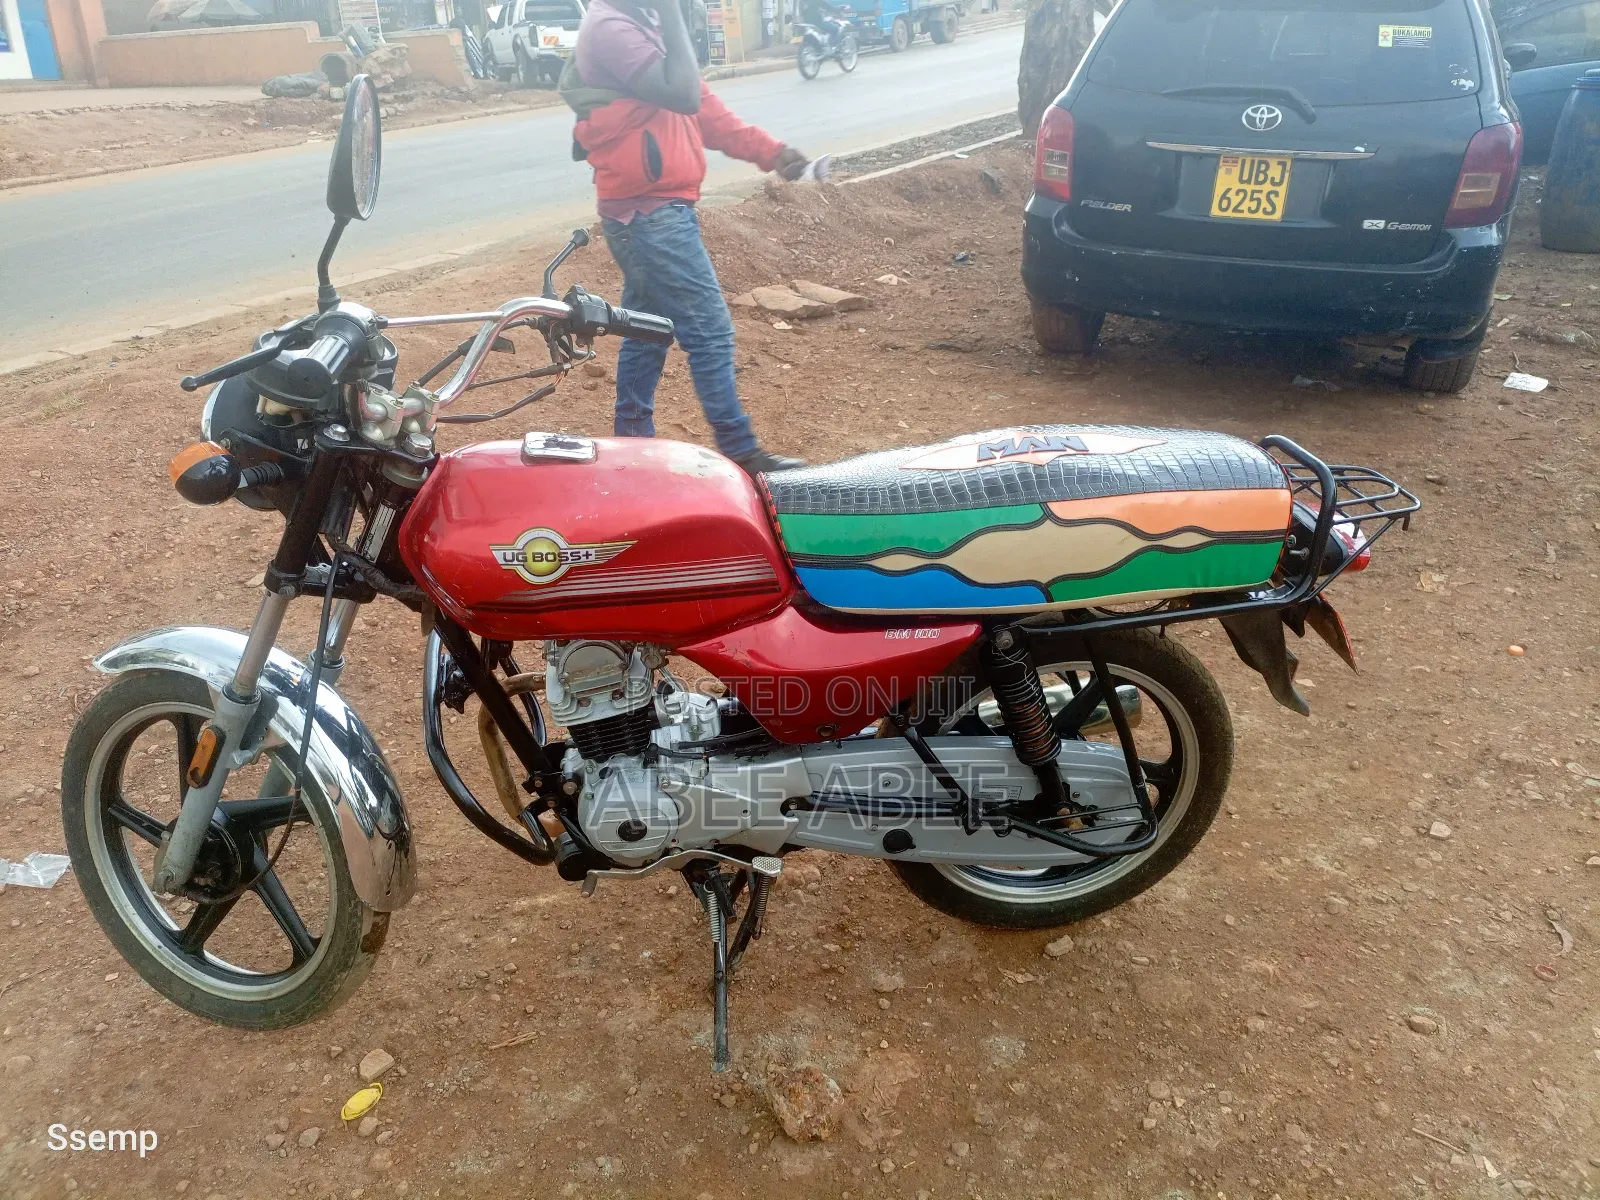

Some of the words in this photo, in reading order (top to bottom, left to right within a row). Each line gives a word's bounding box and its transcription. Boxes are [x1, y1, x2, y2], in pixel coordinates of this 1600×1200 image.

[1392, 29, 1431, 37] BUKALANGO
[1238, 158, 1288, 187] UBJ
[1080, 199, 1132, 212] FIELDER
[1217, 187, 1280, 216] 625S
[977, 435, 1089, 461] MAN
[502, 551, 528, 563] UG
[884, 628, 912, 639] BM
[914, 628, 940, 639] 100
